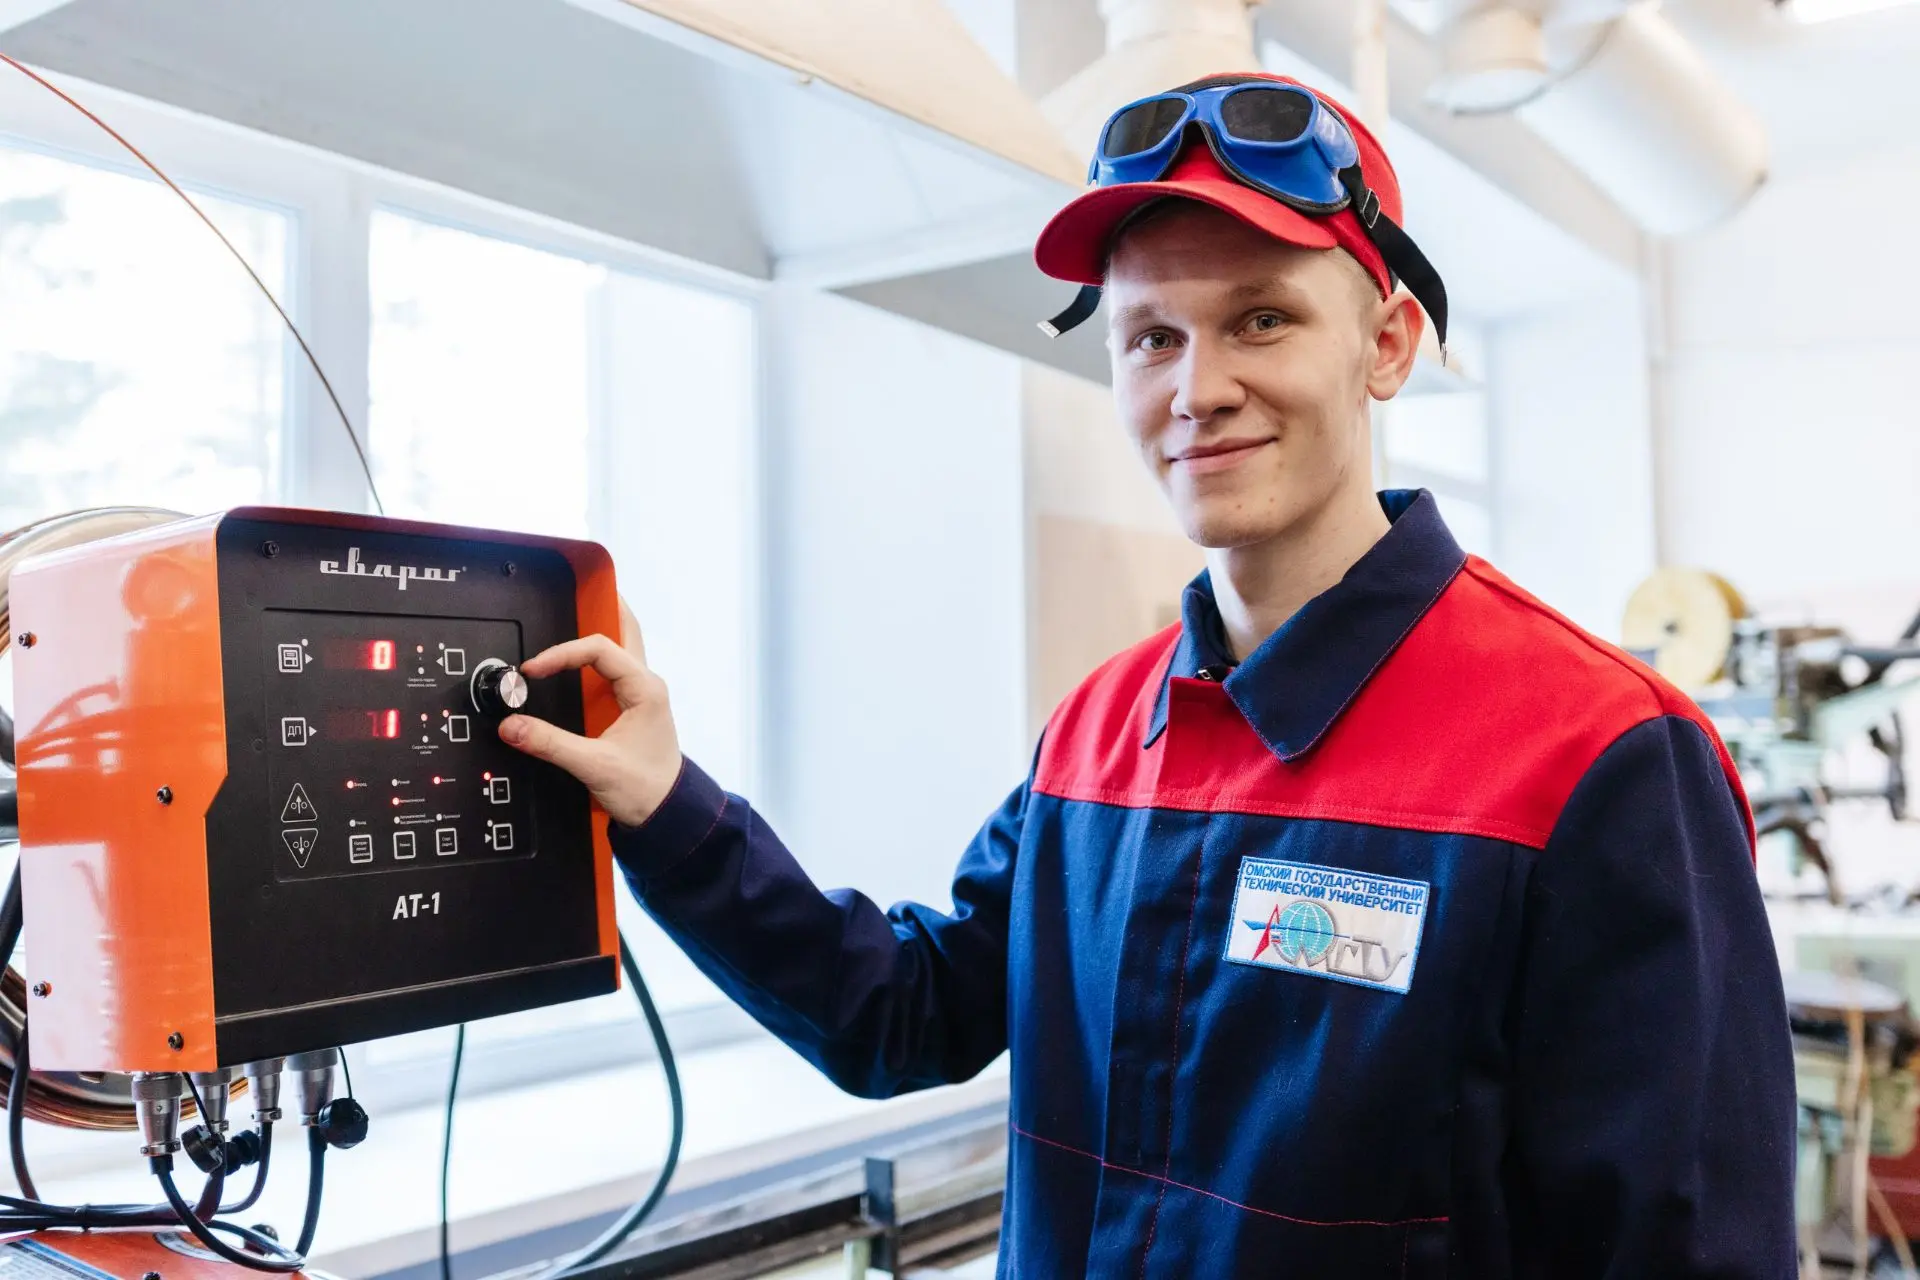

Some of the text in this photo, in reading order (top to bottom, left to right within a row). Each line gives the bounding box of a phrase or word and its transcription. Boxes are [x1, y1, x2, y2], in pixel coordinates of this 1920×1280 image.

[371, 640, 394, 670] 0
[288, 725, 302, 737] ДП
[1243, 877, 1423, 916] ТЕХНИЧЕСКИЙ УНИВЕРСИТЕТ
[1245, 863, 1425, 901] ОМСКИЙ ГОСУДАРСТВЕННЫЙ
